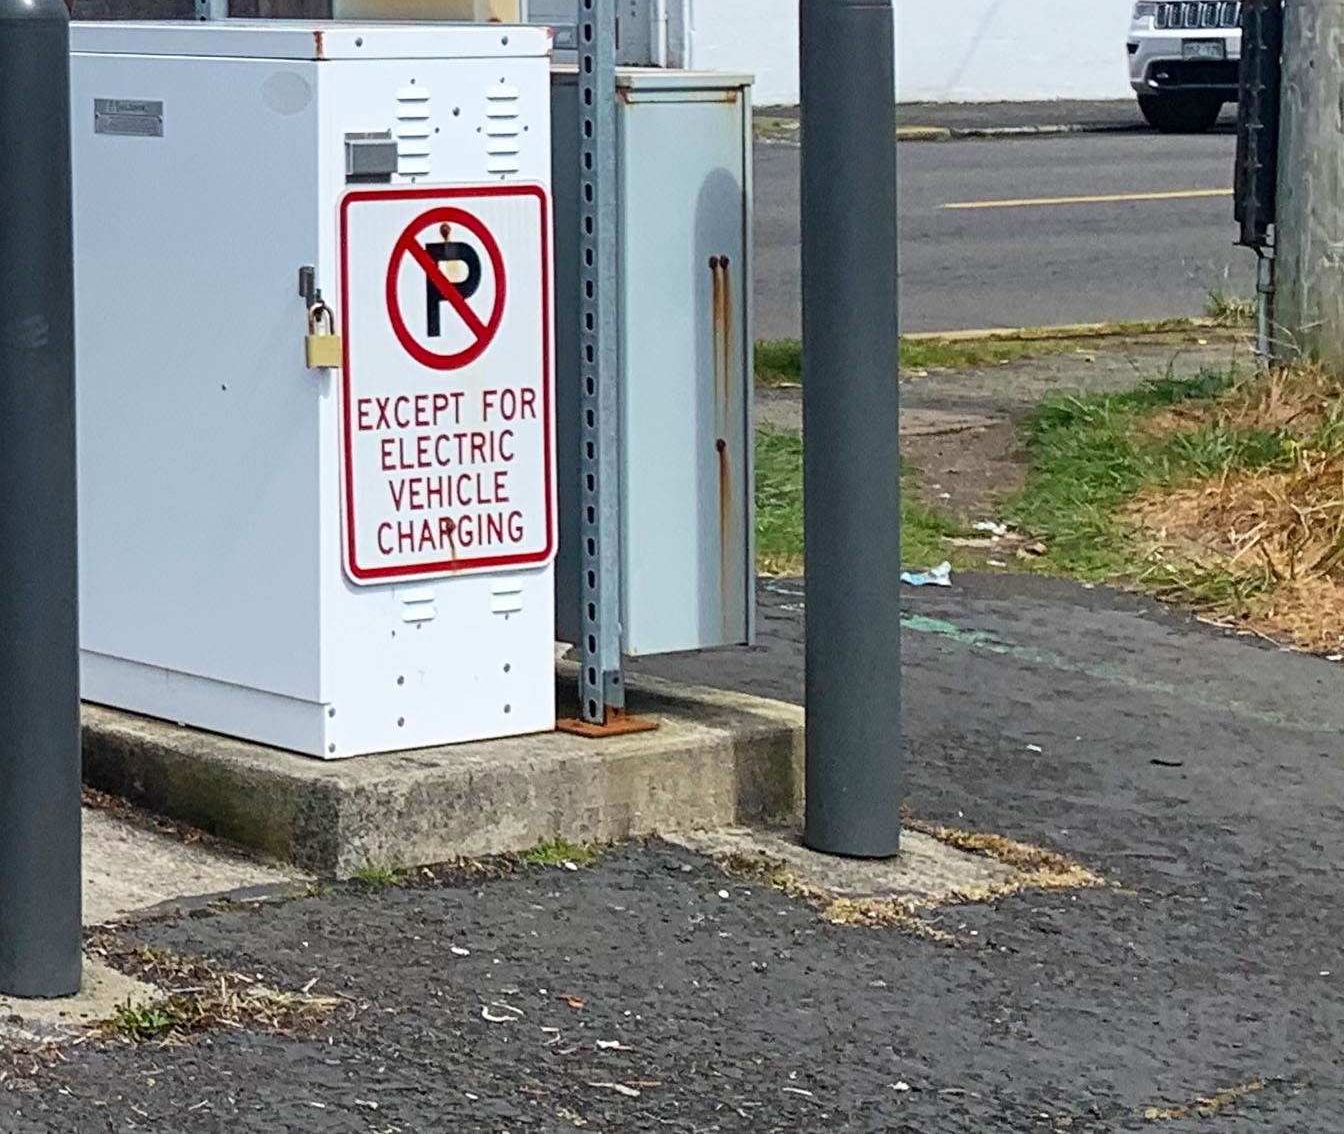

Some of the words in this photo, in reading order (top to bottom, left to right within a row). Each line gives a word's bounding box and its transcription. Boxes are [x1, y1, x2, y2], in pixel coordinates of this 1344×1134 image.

[357, 392, 465, 431] EXCEPT
[482, 388, 536, 422] FOR
[381, 429, 515, 471] ELECTRIC
[388, 470, 510, 512] VEHICLE
[377, 510, 524, 555] CHARGING
